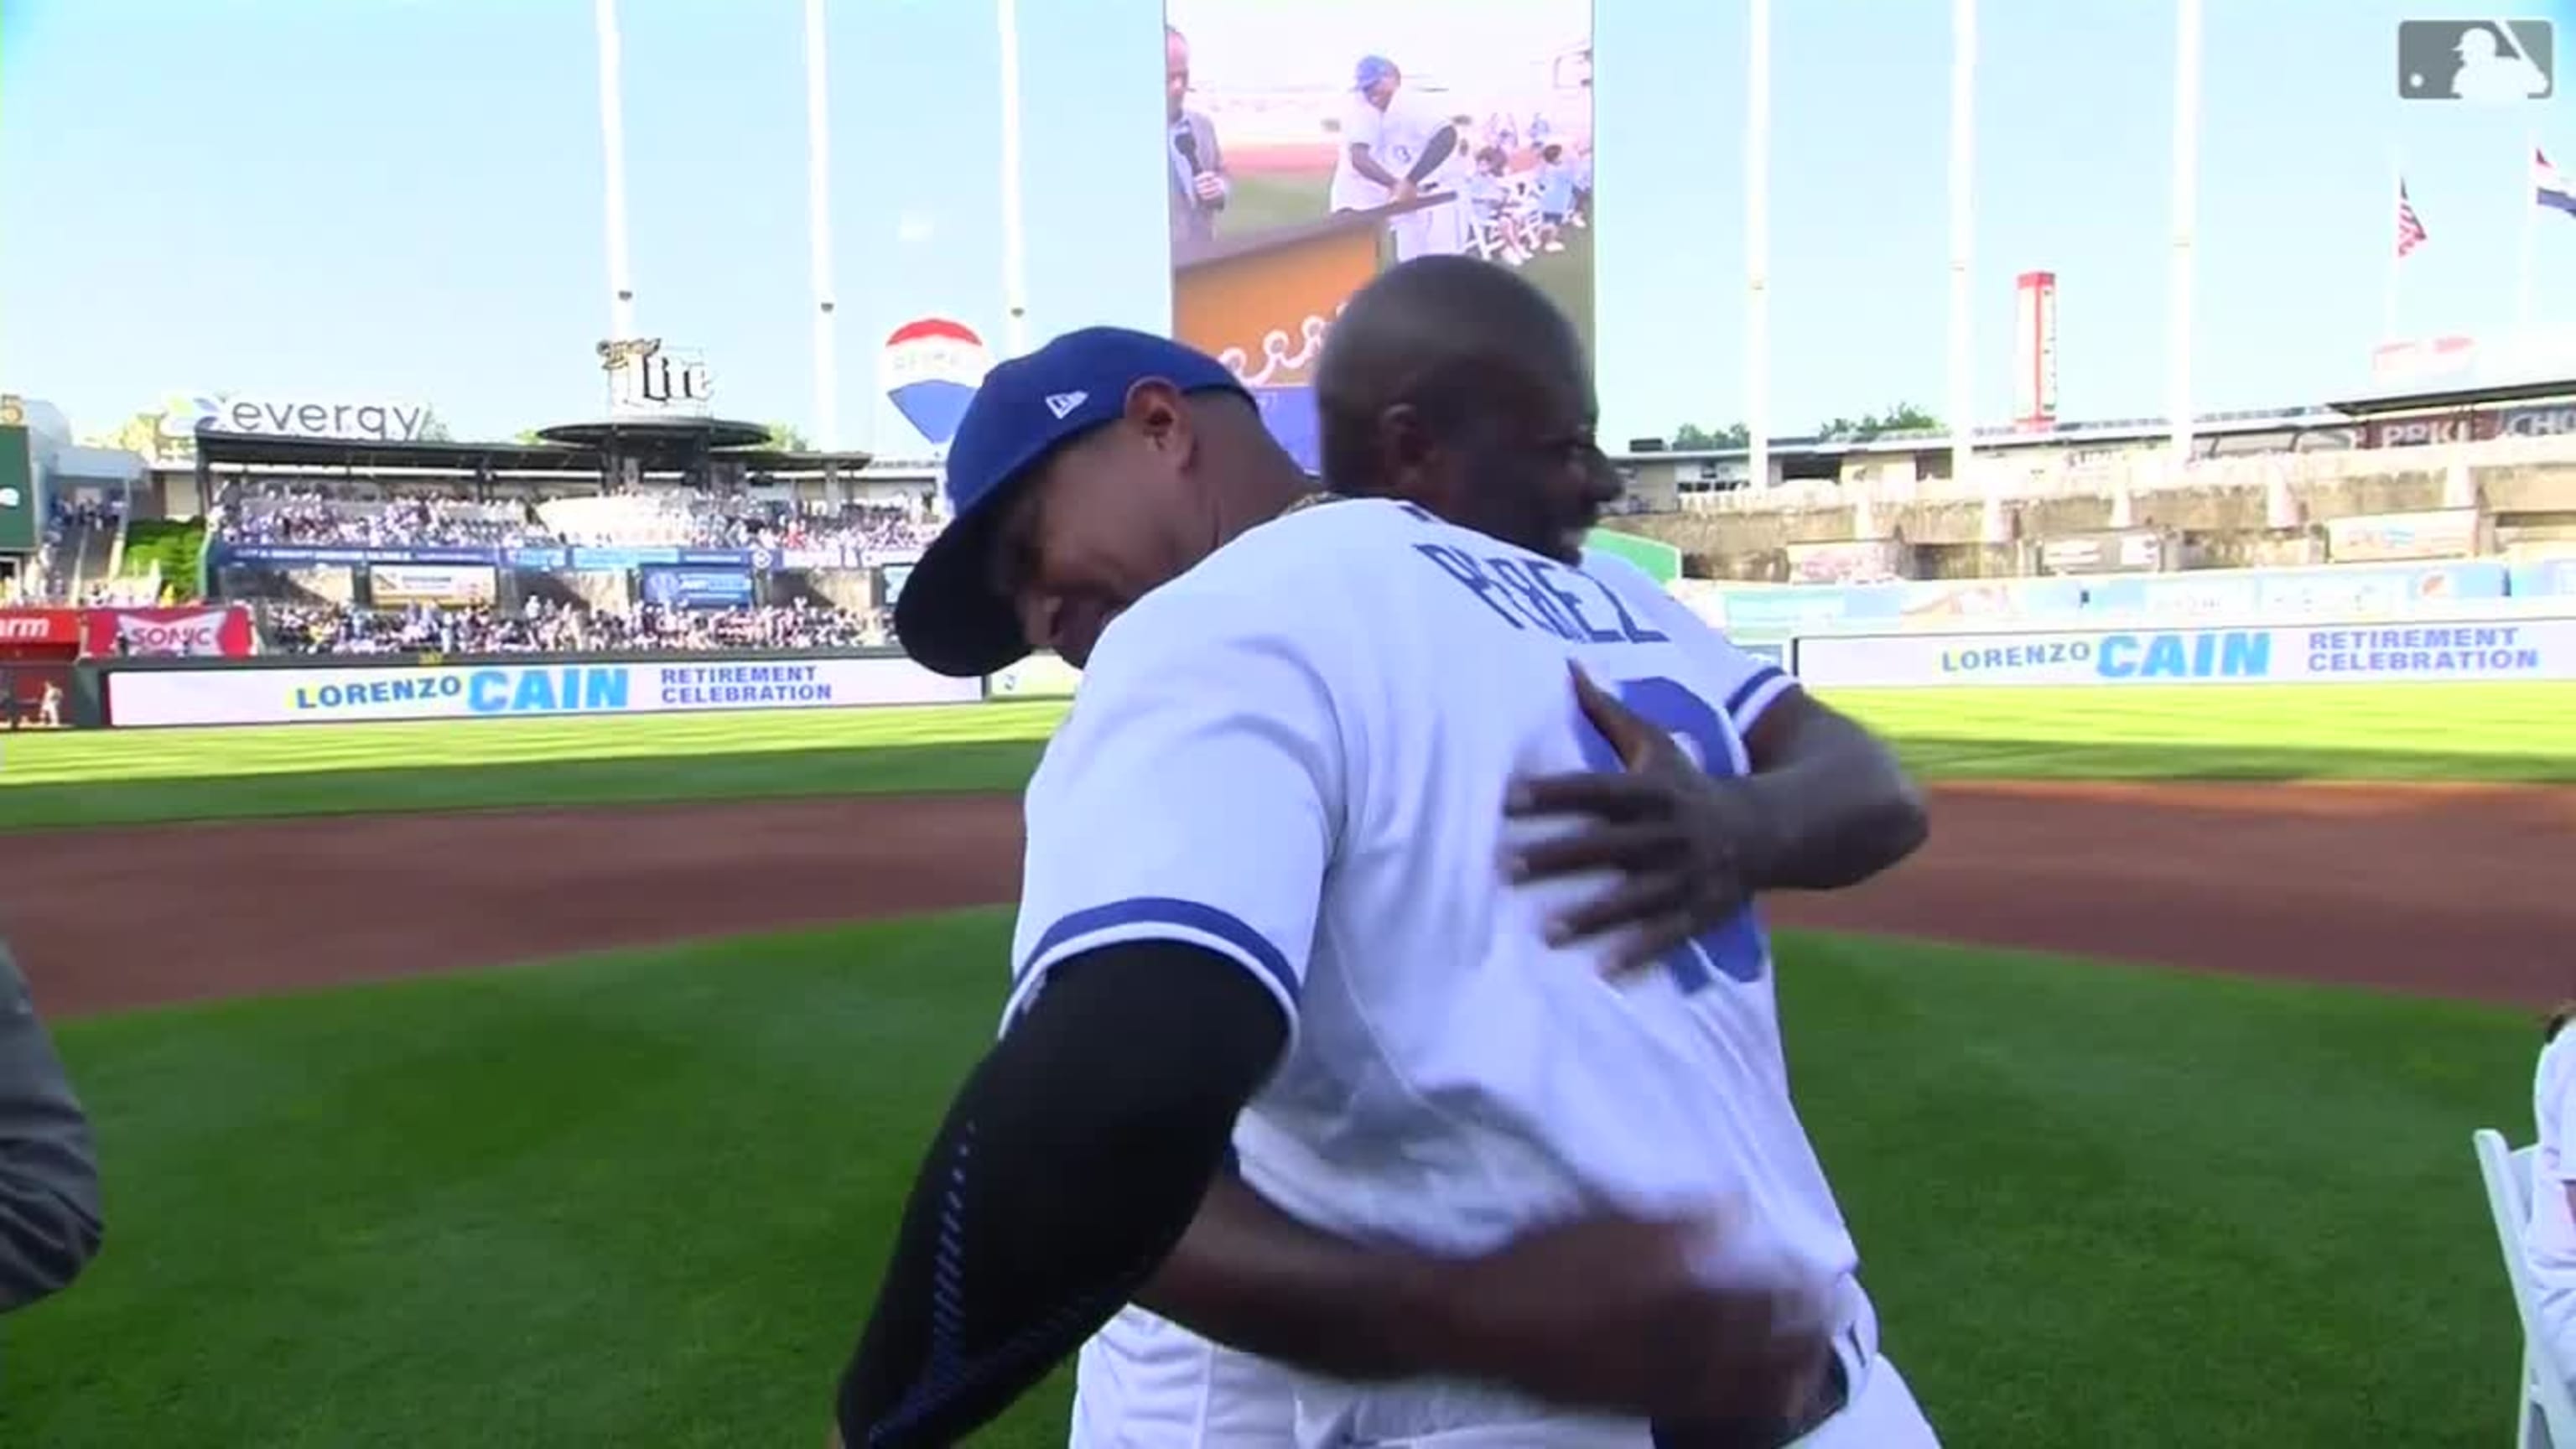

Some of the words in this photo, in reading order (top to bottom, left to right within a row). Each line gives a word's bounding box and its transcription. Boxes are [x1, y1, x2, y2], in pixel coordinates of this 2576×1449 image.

[232, 402, 419, 441] evergy
[2309, 627, 2520, 649] RETIREMENT
[1941, 641, 2090, 672] LORENZO
[2096, 631, 2272, 678] CAIN
[2308, 649, 2539, 672] CELEBRATION
[661, 666, 817, 684] RETIREMENT
[296, 675, 461, 709] LORENZO
[469, 668, 629, 712] CAIN
[661, 684, 831, 704] CELEBRATION
